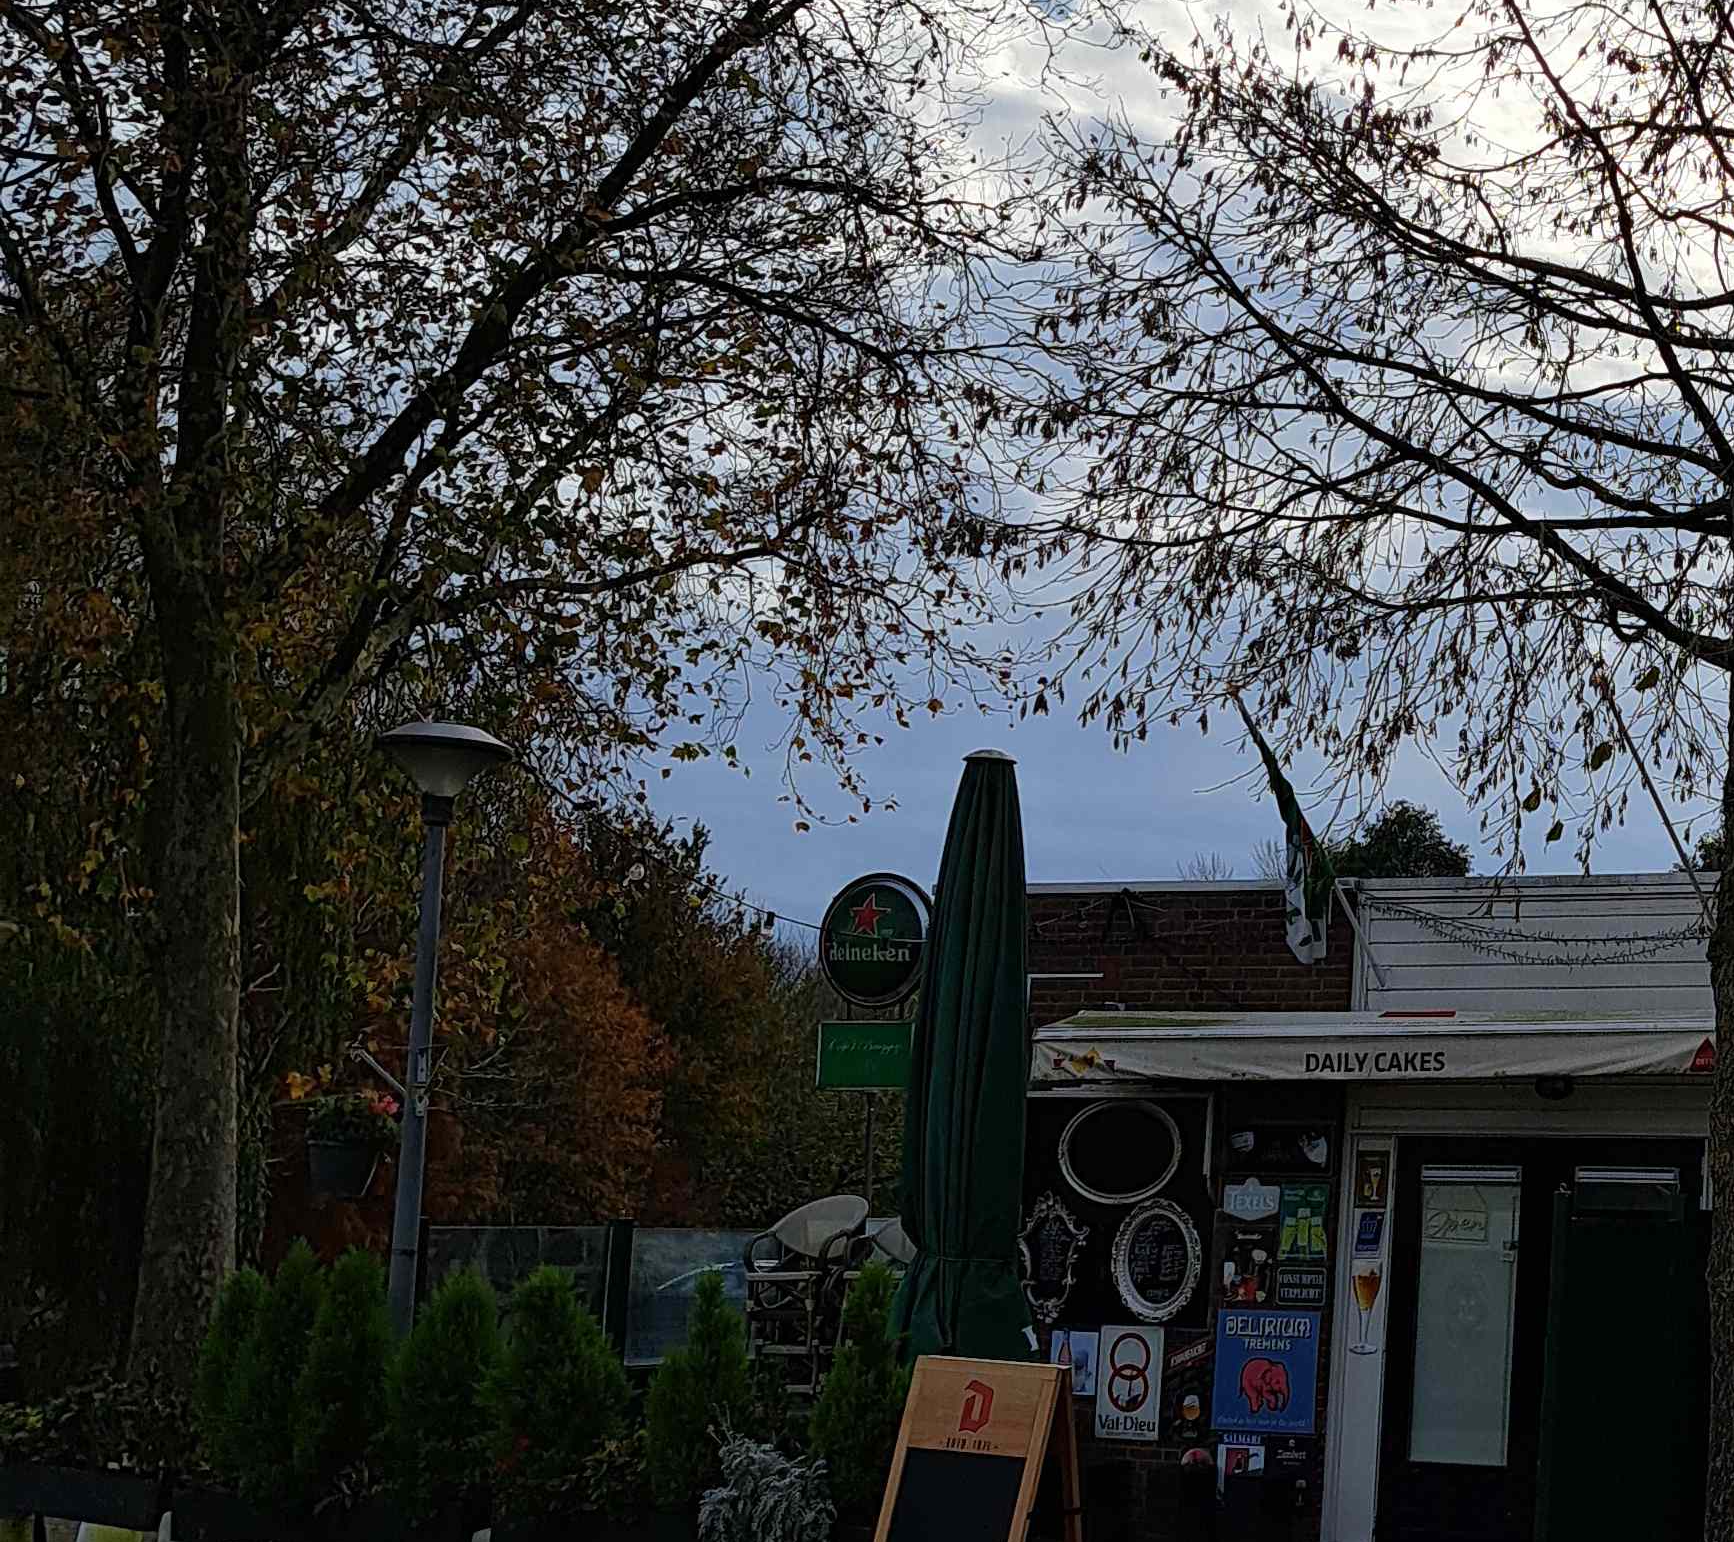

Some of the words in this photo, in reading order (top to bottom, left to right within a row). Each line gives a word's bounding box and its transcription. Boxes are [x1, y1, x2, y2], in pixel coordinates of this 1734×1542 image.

[1305, 1053, 1368, 1072] DAILY
[1374, 1051, 1445, 1071] CAKES
[1225, 1316, 1312, 1338] DELIRIUM
[1244, 1338, 1293, 1352] TREMENS
